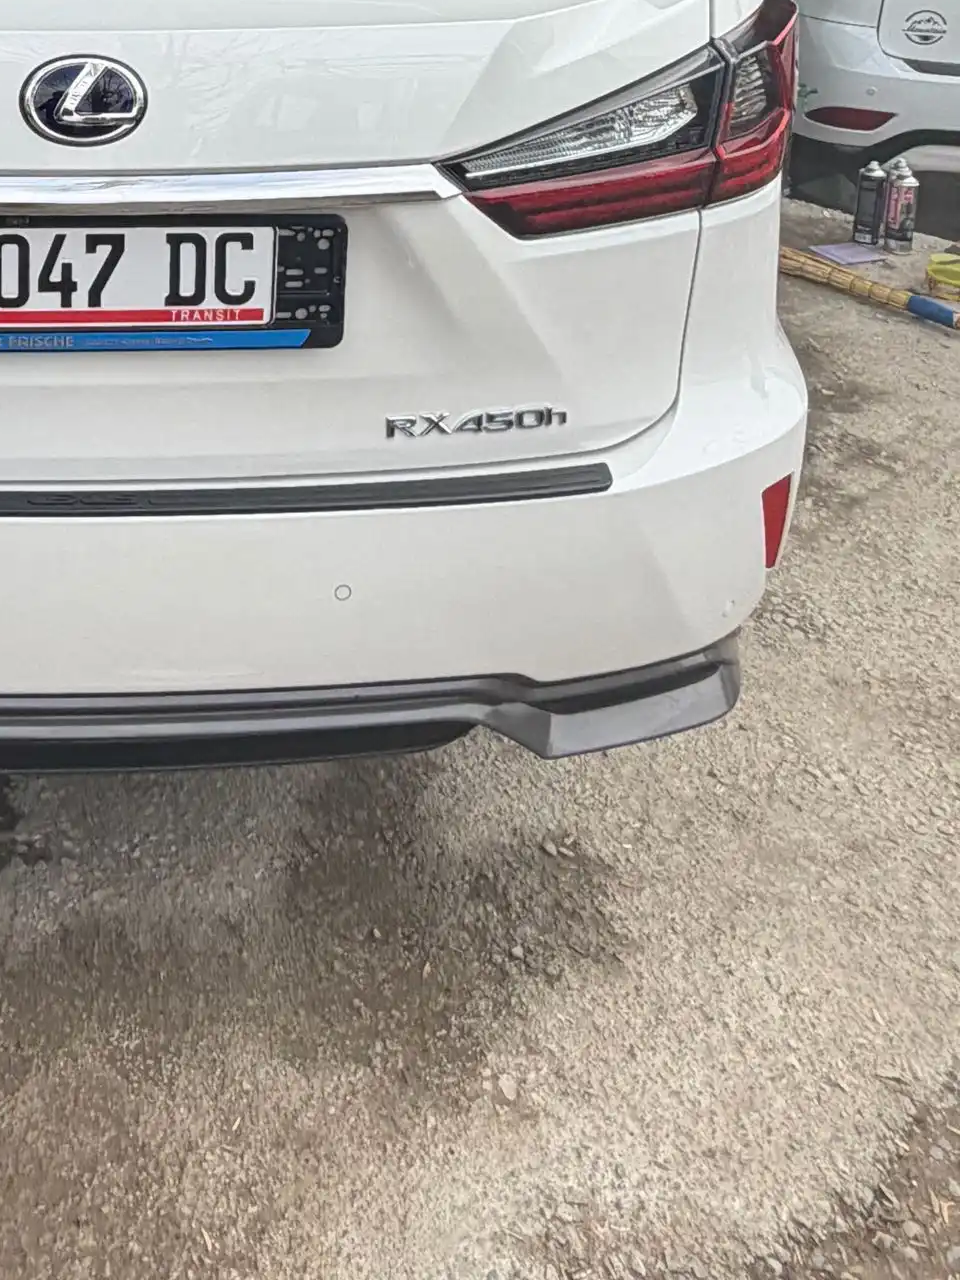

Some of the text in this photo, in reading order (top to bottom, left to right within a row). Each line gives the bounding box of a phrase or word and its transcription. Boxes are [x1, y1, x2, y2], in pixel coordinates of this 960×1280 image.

[164, 232, 257, 307] DC
[170, 308, 241, 321] TRANSIT
[8, 336, 74, 348] FRISCHE
